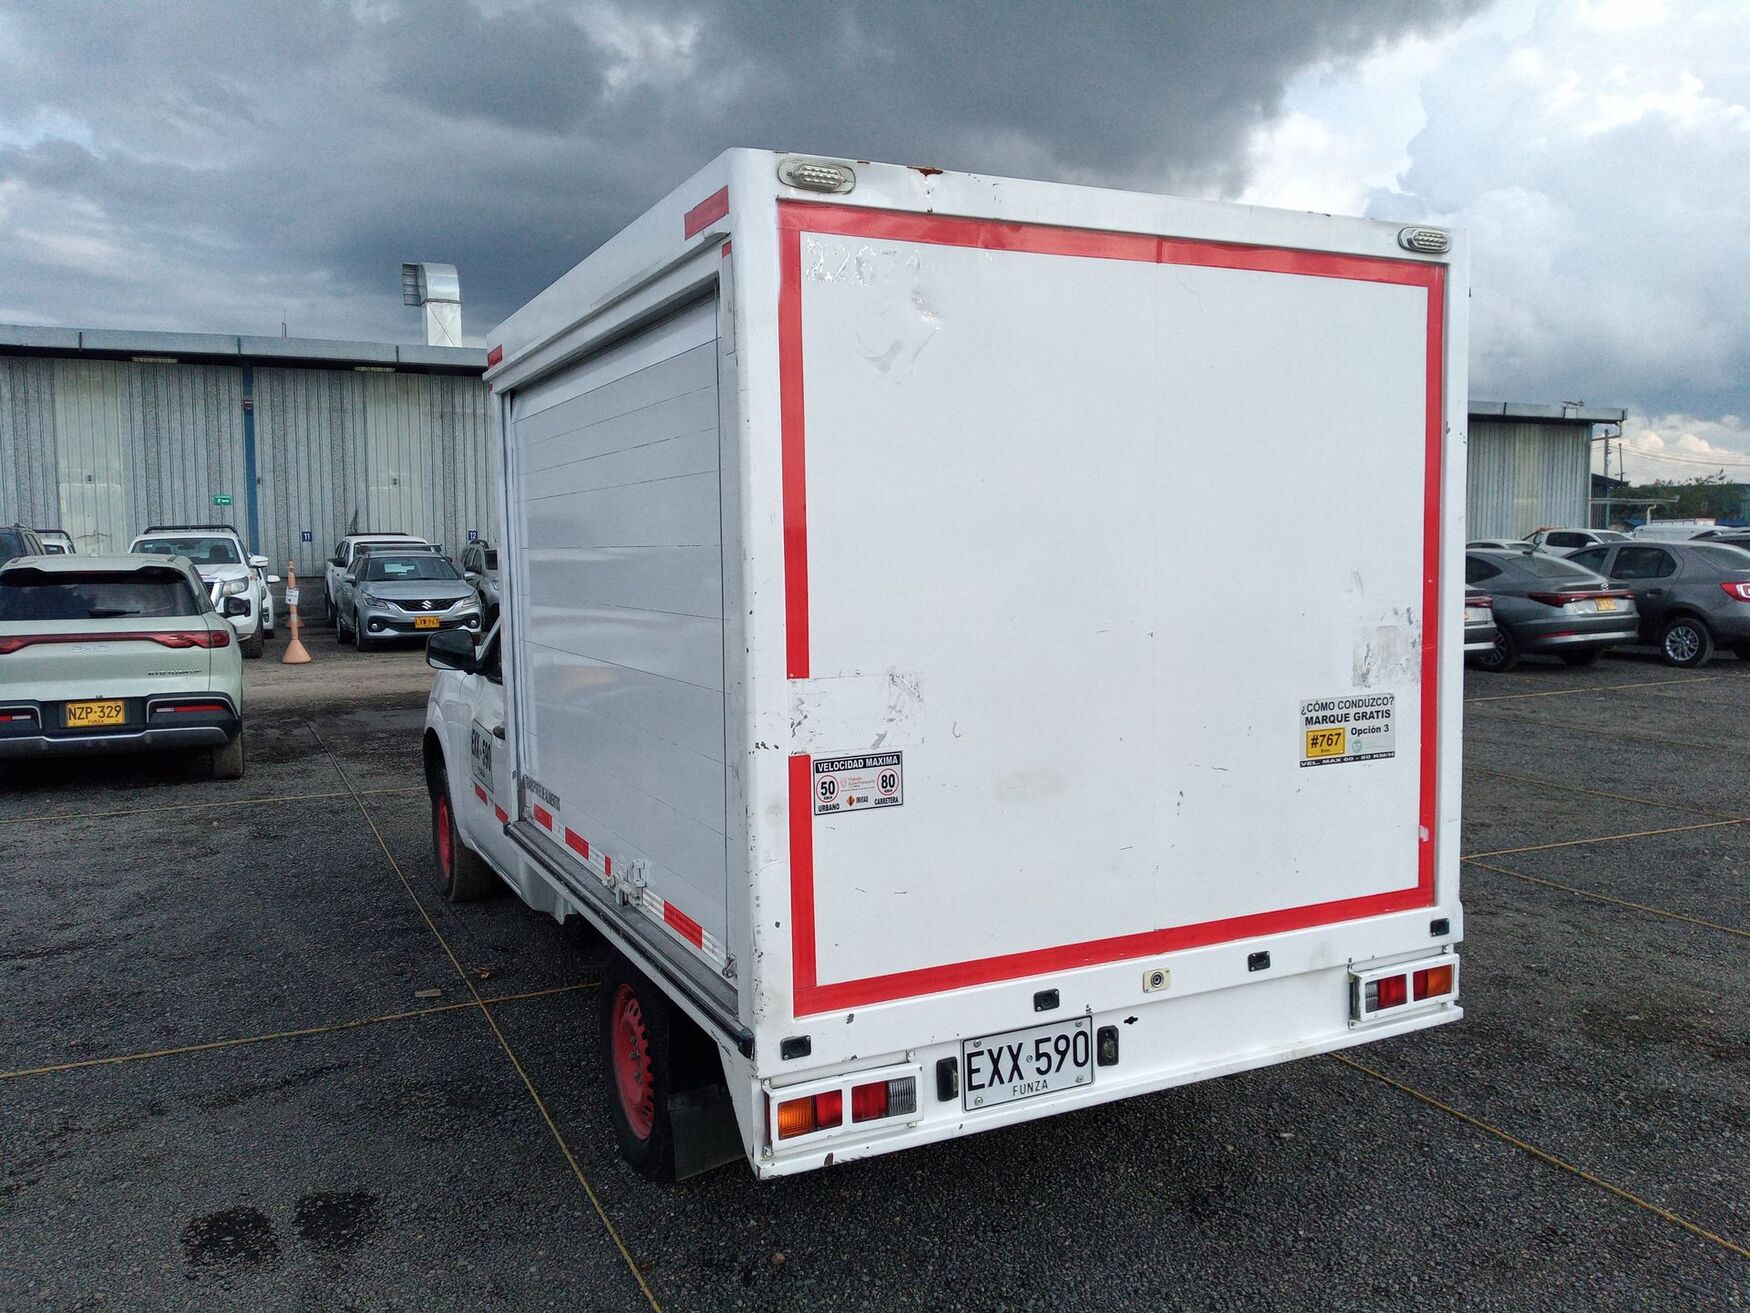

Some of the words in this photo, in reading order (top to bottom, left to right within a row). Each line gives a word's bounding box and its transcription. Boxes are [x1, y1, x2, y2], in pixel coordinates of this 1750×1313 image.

[1301, 701, 1335, 716] ¿CÓMO
[1338, 697, 1395, 710] CONDUZCO?
[1305, 713, 1350, 726] MARQUE
[1353, 709, 1391, 722] GRATIS
[1351, 726, 1381, 737] Opción
[1384, 724, 1389, 732] 3
[1310, 733, 1342, 749] #767
[818, 760, 864, 771] VELOCIDAD
[866, 755, 898, 767] MAXIMA
[820, 780, 835, 796] 50
[881, 773, 895, 789] 80
[818, 803, 840, 812] URBANO
[875, 796, 899, 806] CARRETERA
[1012, 1079, 1048, 1096] FUNZA
